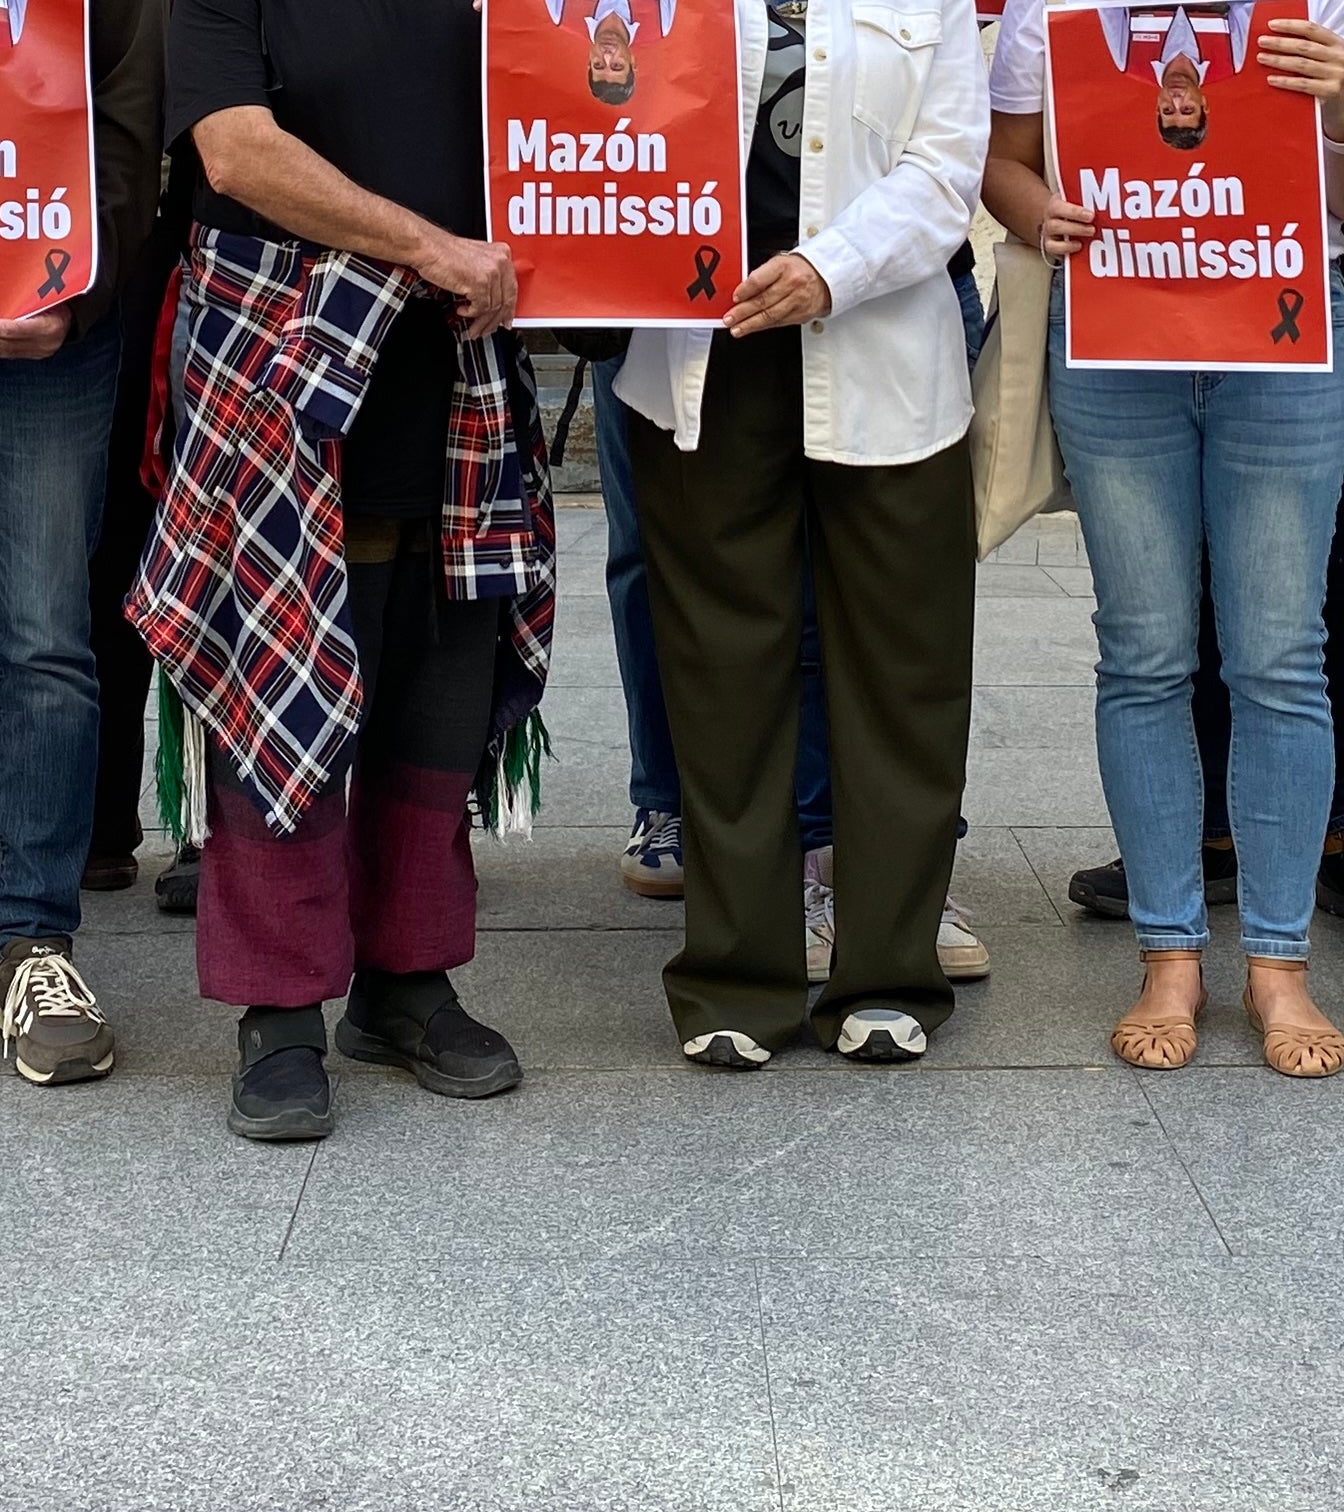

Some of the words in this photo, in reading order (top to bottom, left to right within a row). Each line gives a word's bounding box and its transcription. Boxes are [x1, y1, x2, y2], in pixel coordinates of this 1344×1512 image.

[508, 118, 666, 172] Mazón
[508, 181, 721, 236] dimissió
[1079, 163, 1244, 220] Mazón
[1090, 223, 1303, 278] dimissió
